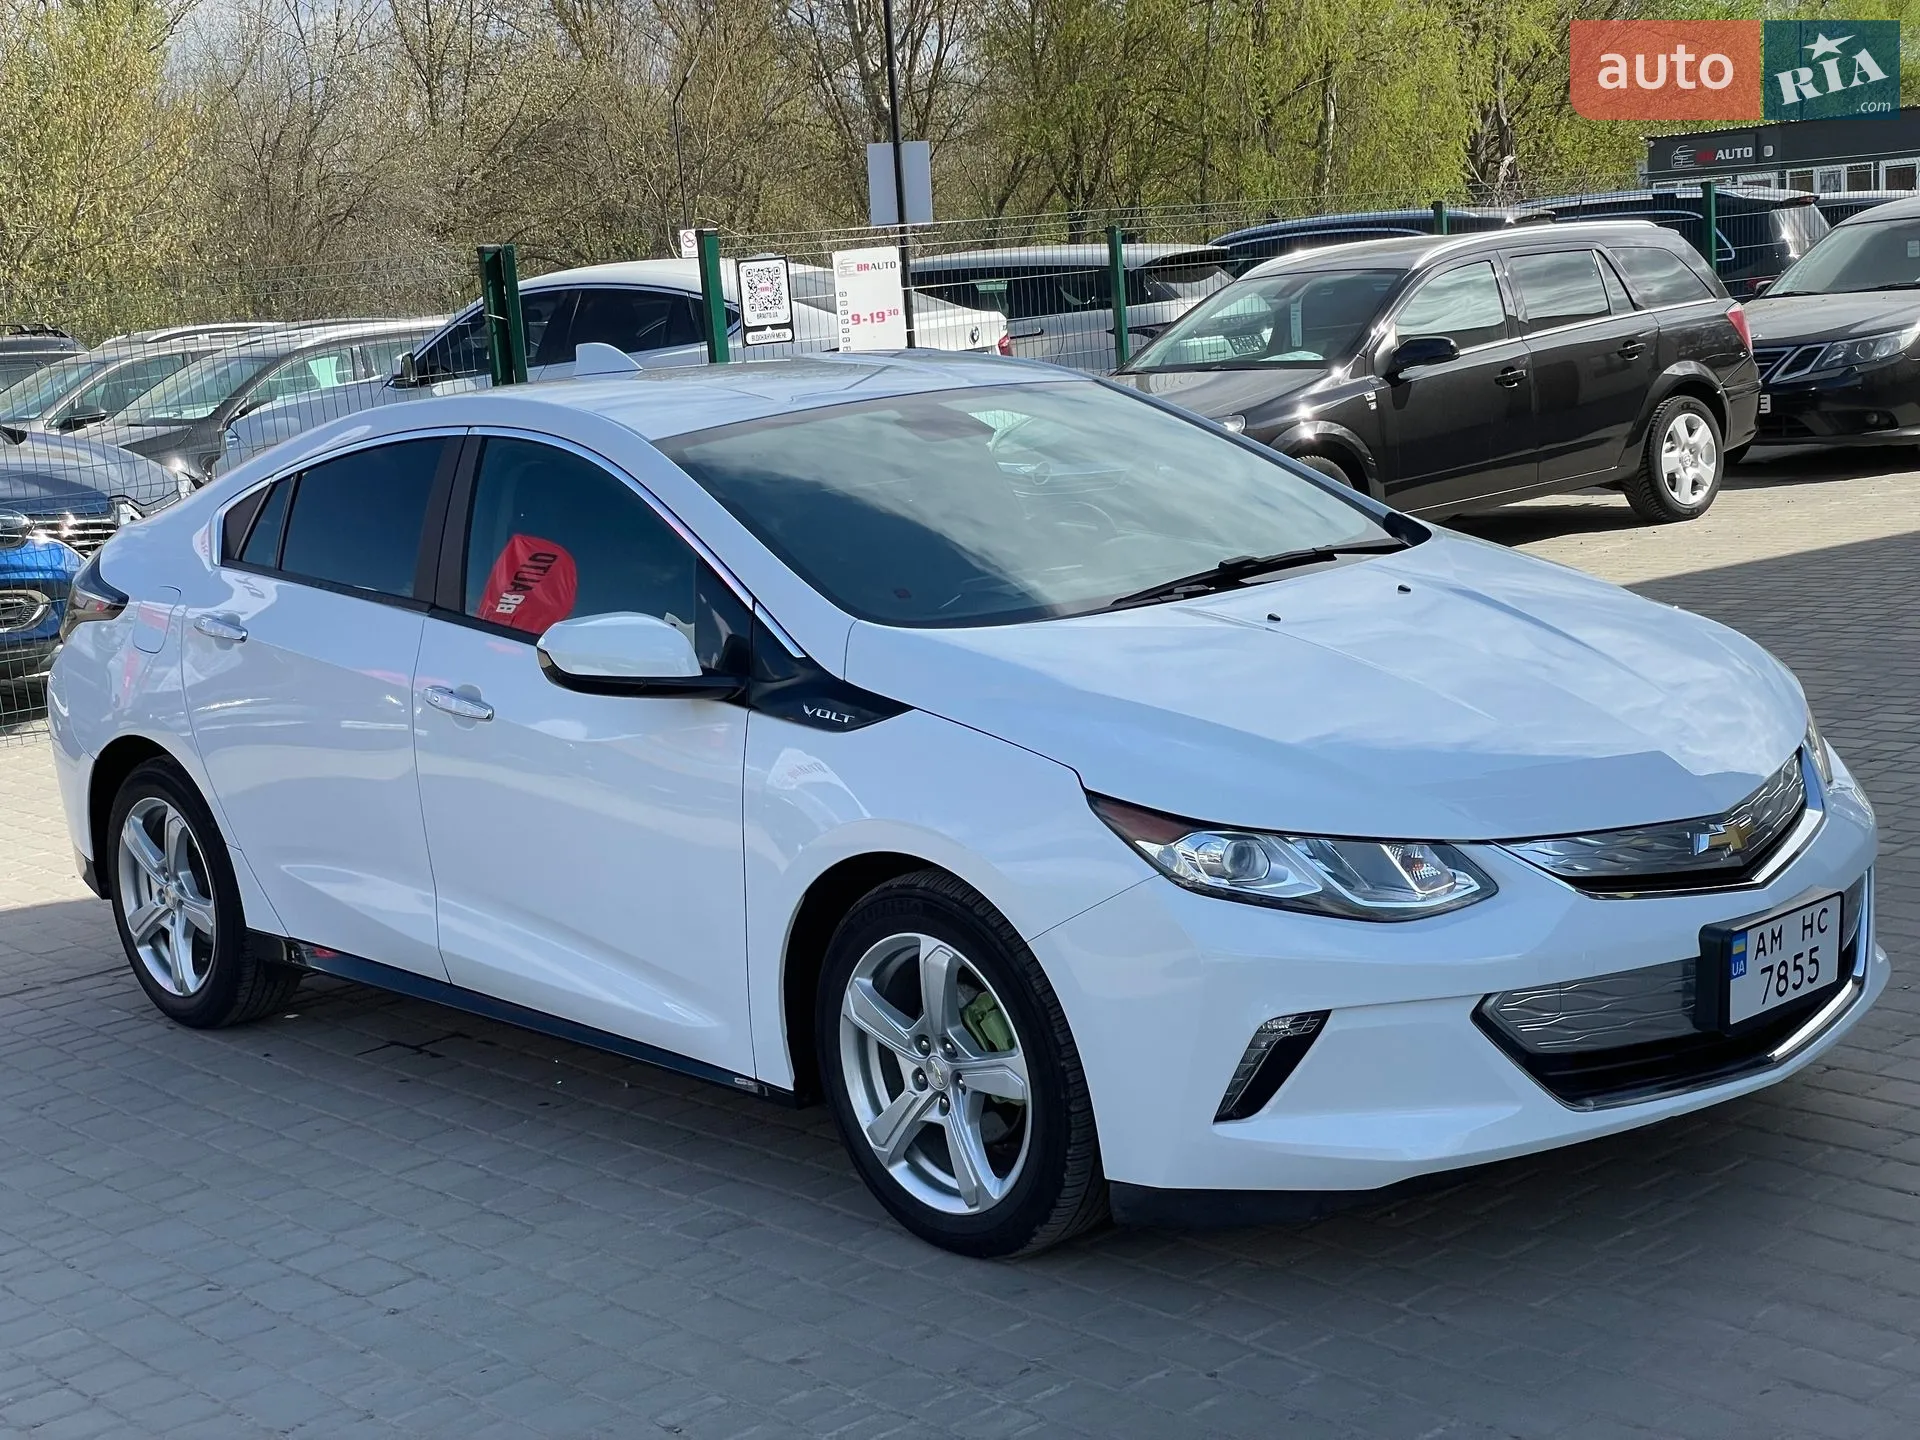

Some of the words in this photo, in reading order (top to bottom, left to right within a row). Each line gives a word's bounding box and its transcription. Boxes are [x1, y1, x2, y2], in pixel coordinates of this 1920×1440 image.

[856, 260, 897, 272] BRAUTO
[803, 704, 856, 723] VOLT
[1754, 924, 1783, 960] AM
[1801, 907, 1828, 942] HC
[1732, 960, 1745, 976] UA
[1760, 945, 1820, 1005] 7855
